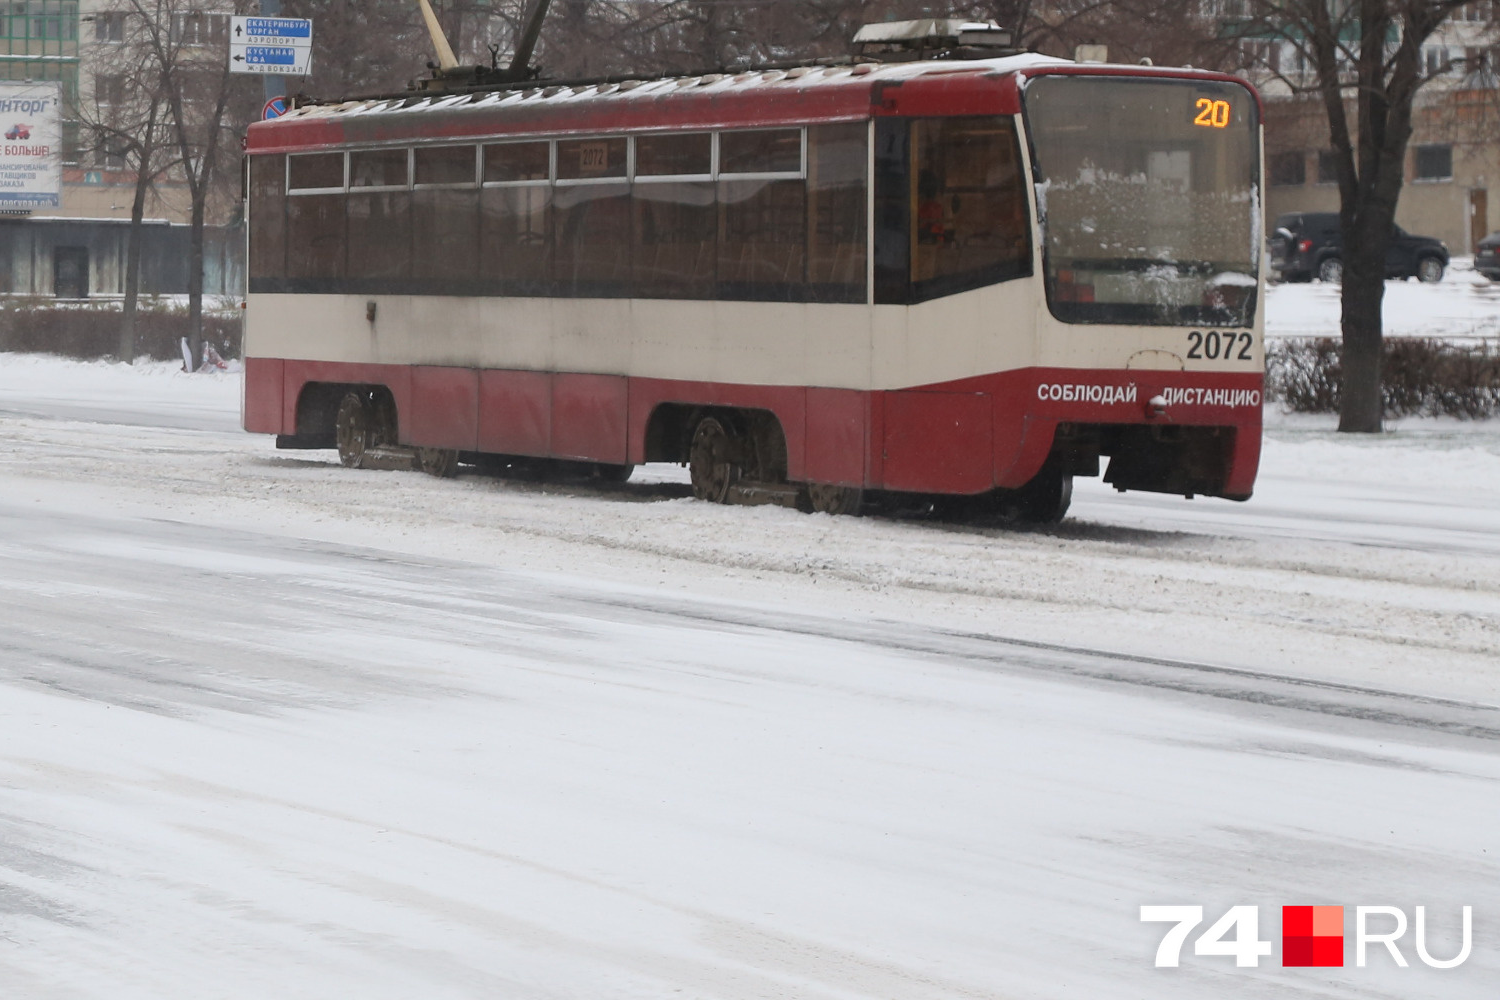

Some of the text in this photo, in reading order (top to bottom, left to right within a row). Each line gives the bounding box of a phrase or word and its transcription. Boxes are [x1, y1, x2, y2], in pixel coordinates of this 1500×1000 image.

[247, 19, 309, 29] ЕКАТЕРИНБУРГ
[247, 28, 280, 36] КУРГАН
[248, 36, 296, 44] АЭРОПОРТ
[267, 65, 304, 74] ВОКЗАЛ
[1194, 97, 1231, 128] 20
[583, 148, 604, 166] 2072
[1187, 331, 1253, 360] 2072
[1037, 382, 1260, 408] СОБЛЮДАЙ ДИСТАНЦИЮ
